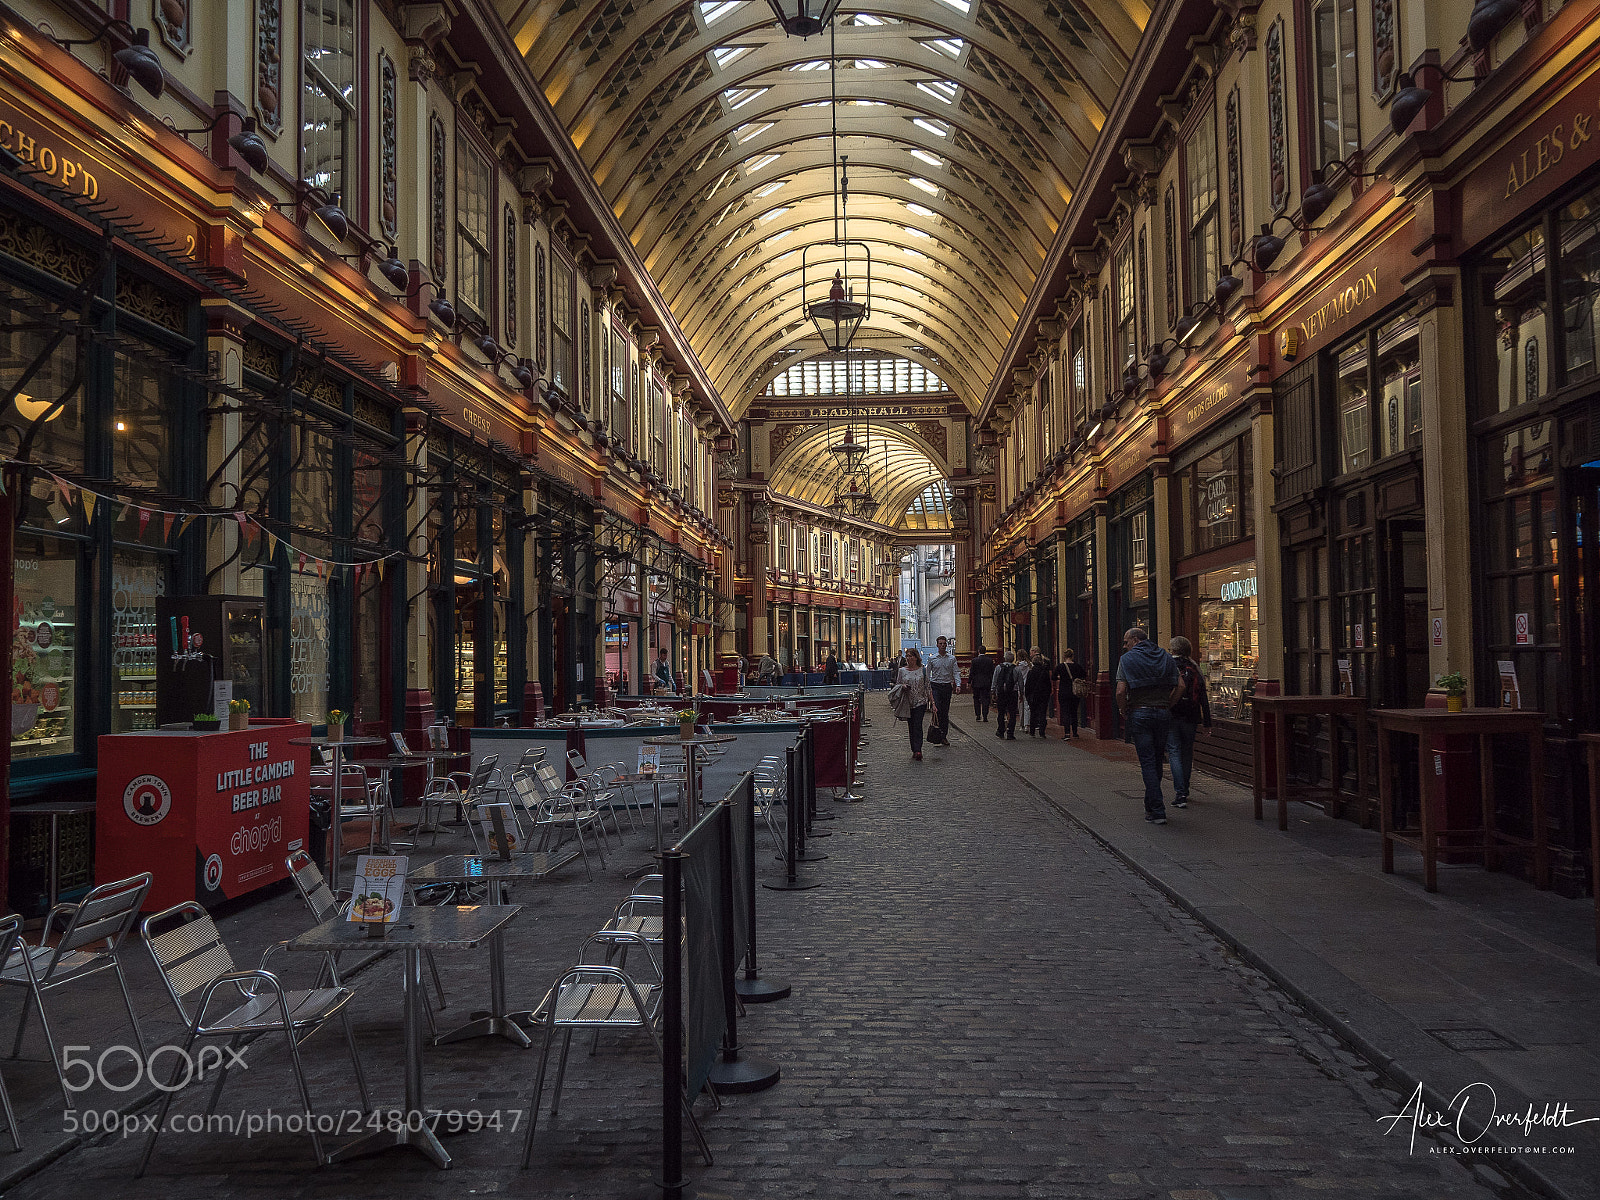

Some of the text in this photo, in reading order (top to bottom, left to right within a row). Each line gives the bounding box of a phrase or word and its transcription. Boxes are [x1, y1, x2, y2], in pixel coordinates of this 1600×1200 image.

[0, 120, 99, 200] CHOP'D
[1503, 112, 1592, 200] ALES &
[1301, 266, 1378, 344] NEW MOON
[809, 406, 908, 418] LEADENHALL
[1187, 382, 1229, 424] CARDS GALORE
[463, 407, 491, 435] CHEESE
[1208, 477, 1226, 500] CARDS
[1221, 579, 1243, 602] CARDS
[248, 741, 269, 762] THE
[126, 777, 169, 797] CAMDEN TOWN
[216, 760, 295, 793] LITTLE CAMDEN
[231, 785, 282, 814] BEER BAR
[130, 810, 164, 823] BREWERY
[254, 812, 260, 820] AT
[230, 815, 282, 856] chop'd
[364, 868, 397, 877] EGGS
